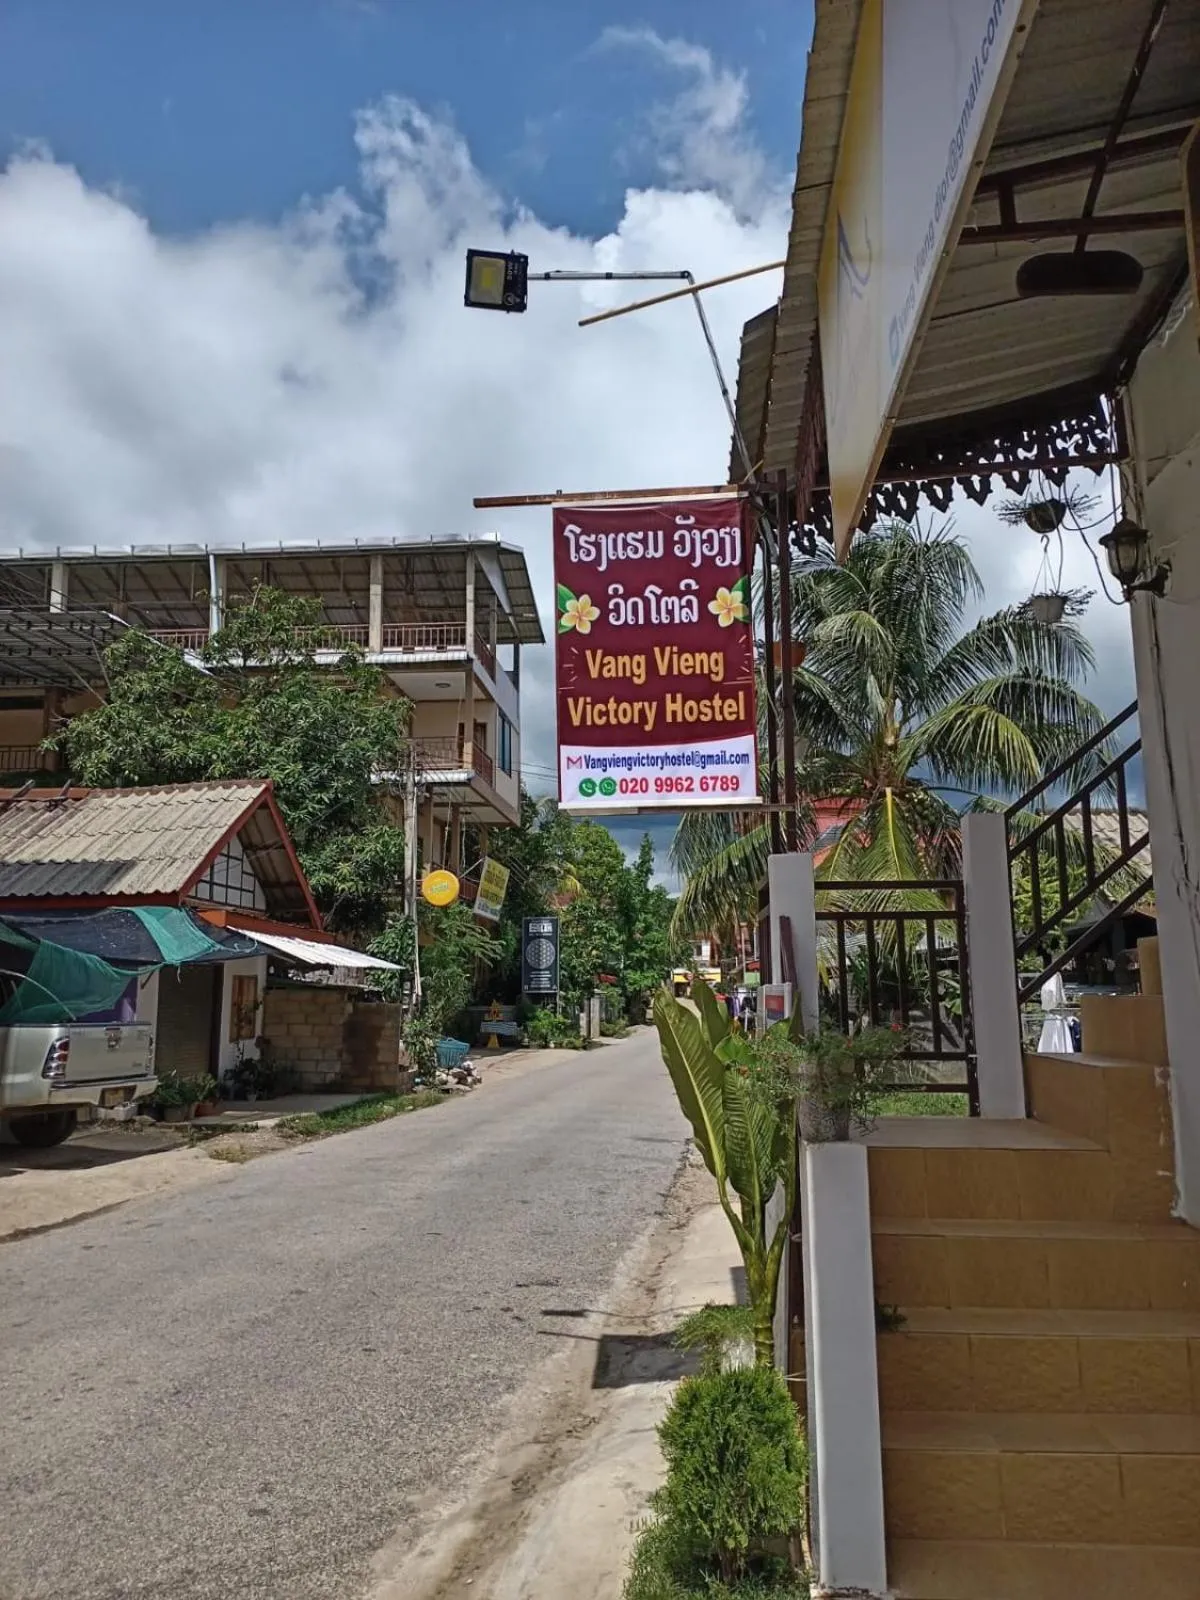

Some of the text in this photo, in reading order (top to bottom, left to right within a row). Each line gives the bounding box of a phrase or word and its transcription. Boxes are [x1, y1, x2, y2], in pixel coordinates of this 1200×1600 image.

[563, 515, 742, 571] ໂຮງແຮມ ວັງວຽງ
[585, 646, 724, 685] Vang Vieng
[567, 691, 746, 731] Victory Hostel
[584, 751, 750, 772] Vangviengvictoryhostel@gmail.com
[619, 775, 740, 794] 020 9962 6789
